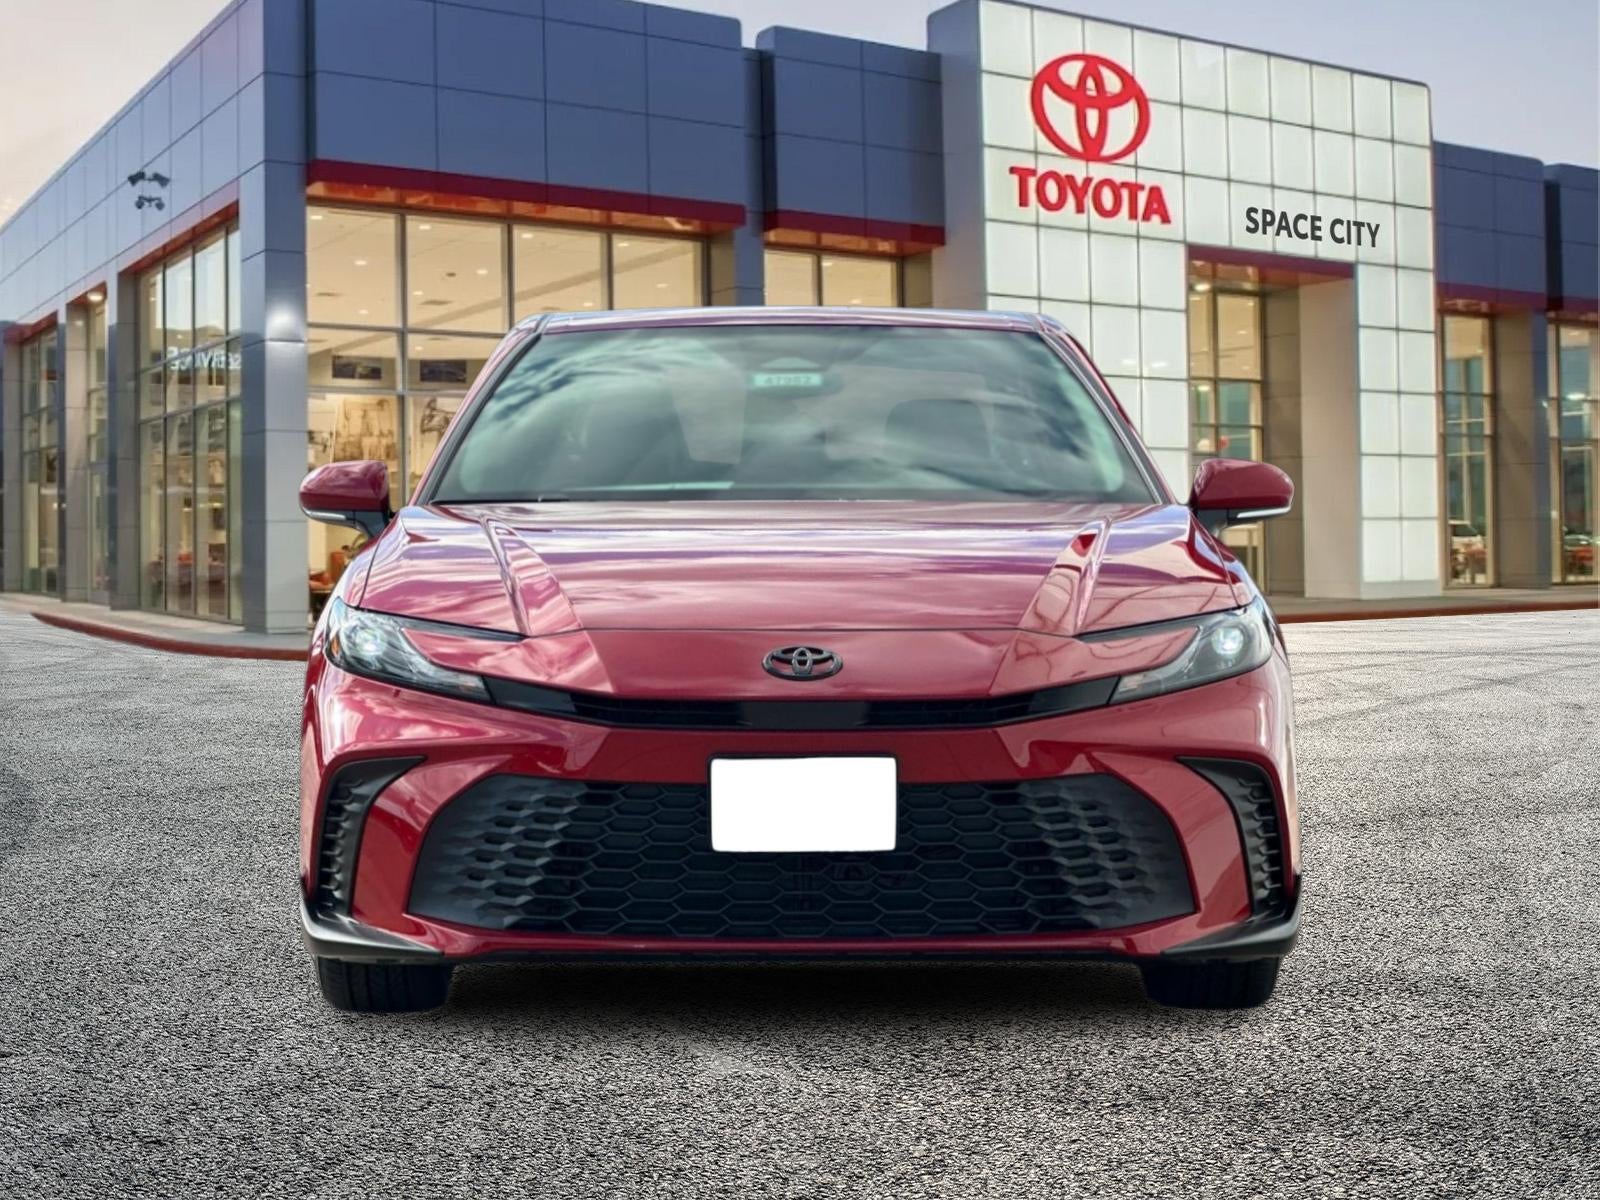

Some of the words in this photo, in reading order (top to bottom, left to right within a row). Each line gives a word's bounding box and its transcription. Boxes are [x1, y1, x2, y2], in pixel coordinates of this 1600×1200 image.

[1009, 166, 1171, 224] TOYOTA
[1245, 206, 1323, 242] SPACE
[1329, 218, 1380, 248] CITY
